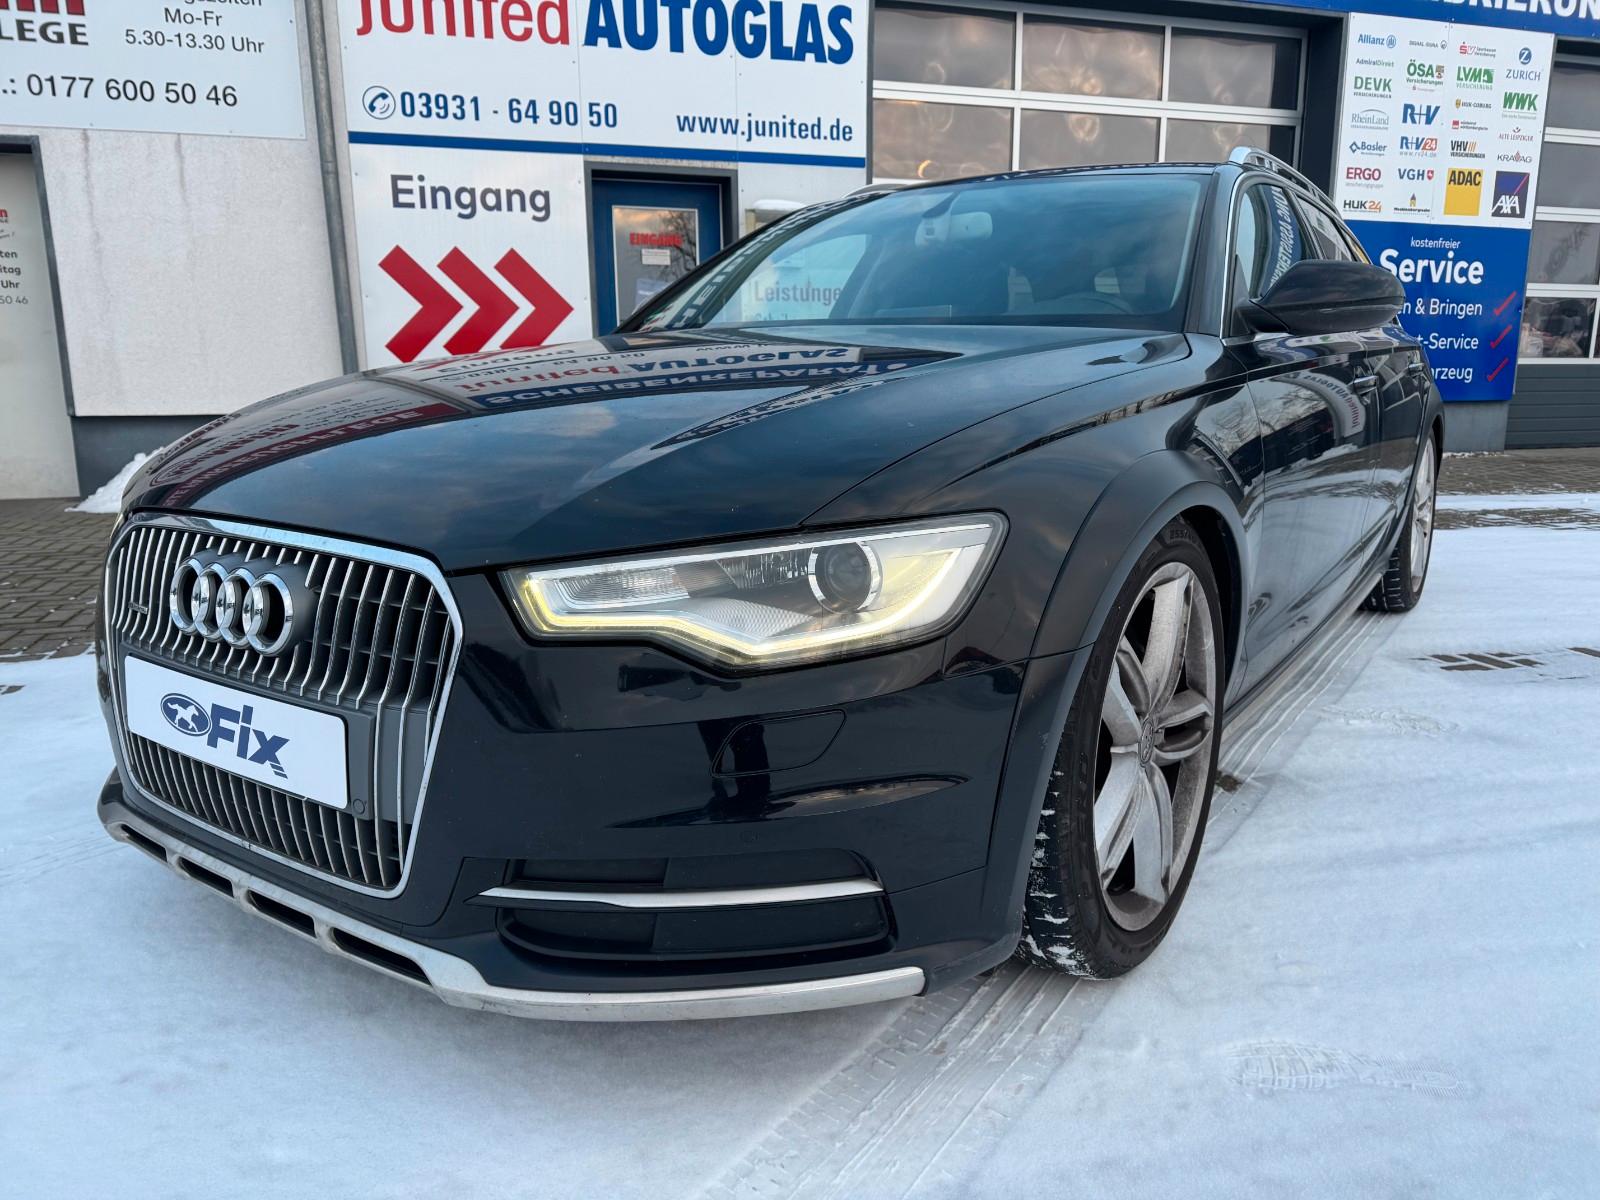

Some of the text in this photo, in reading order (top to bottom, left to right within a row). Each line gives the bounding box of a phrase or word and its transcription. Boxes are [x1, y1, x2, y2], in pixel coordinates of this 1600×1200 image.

[164, 7, 223, 26] Mo-Fr
[125, 29, 265, 53] 5.30-13.30 Uhr
[583, 0, 854, 65] AUTOGLAS
[1358, 34, 1385, 46] Allianz
[1407, 59, 1435, 78] ÖSA
[1456, 66, 1482, 83] LVM
[1506, 69, 1541, 81] ZURICH
[27, 74, 94, 98] 0177
[105, 78, 155, 102] 600
[165, 82, 197, 104] 50
[206, 85, 238, 107] 46
[1354, 76, 1392, 92] DEVK
[400, 92, 480, 122] 03931
[508, 98, 540, 124] 64
[549, 101, 578, 126] 90
[588, 102, 618, 128] 50
[1503, 92, 1538, 111] WWK
[1402, 103, 1440, 125] R+V
[676, 113, 853, 142] www.junited.de
[1360, 141, 1388, 152] Basler
[1450, 140, 1468, 151] VHV
[1346, 167, 1382, 180] ERGO
[1398, 168, 1425, 180] VGH
[1448, 170, 1482, 186] ADAC
[390, 174, 551, 222] Eingang
[1491, 194, 1520, 214] AXA
[1410, 237, 1461, 249] kostenfreier
[1380, 248, 1484, 285] Service
[1, 280, 20, 288] Uhr
[754, 280, 841, 306] Leistunge
[1415, 298, 1425, 315] &
[1429, 299, 1482, 319] Bringen
[207, 703, 290, 779] Fix
